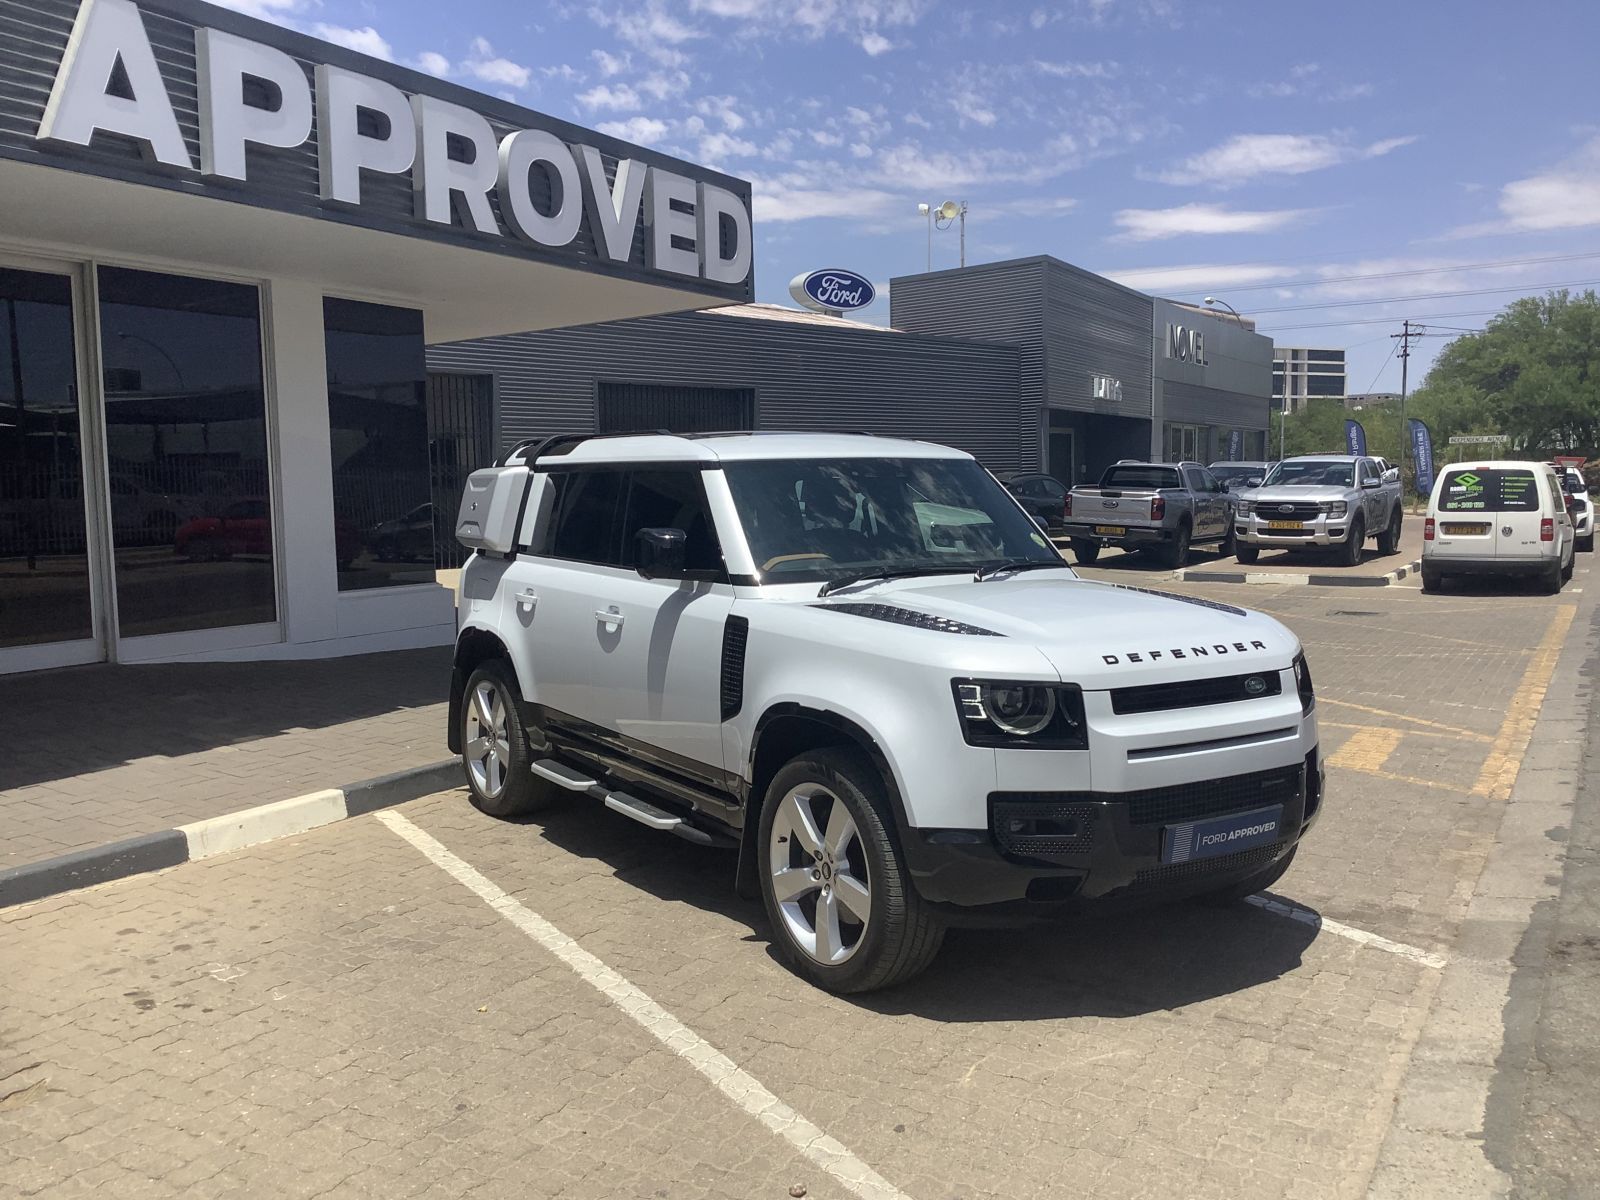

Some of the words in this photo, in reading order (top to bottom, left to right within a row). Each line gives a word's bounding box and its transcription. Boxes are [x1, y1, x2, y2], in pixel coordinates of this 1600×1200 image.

[36, 0, 752, 285] APPROVED
[817, 275, 863, 306] Ford
[1165, 322, 1209, 367] NOVEL
[1102, 640, 1267, 665] DEFENDER
[1202, 832, 1227, 846] FORD
[1227, 821, 1276, 841] APPROVED
